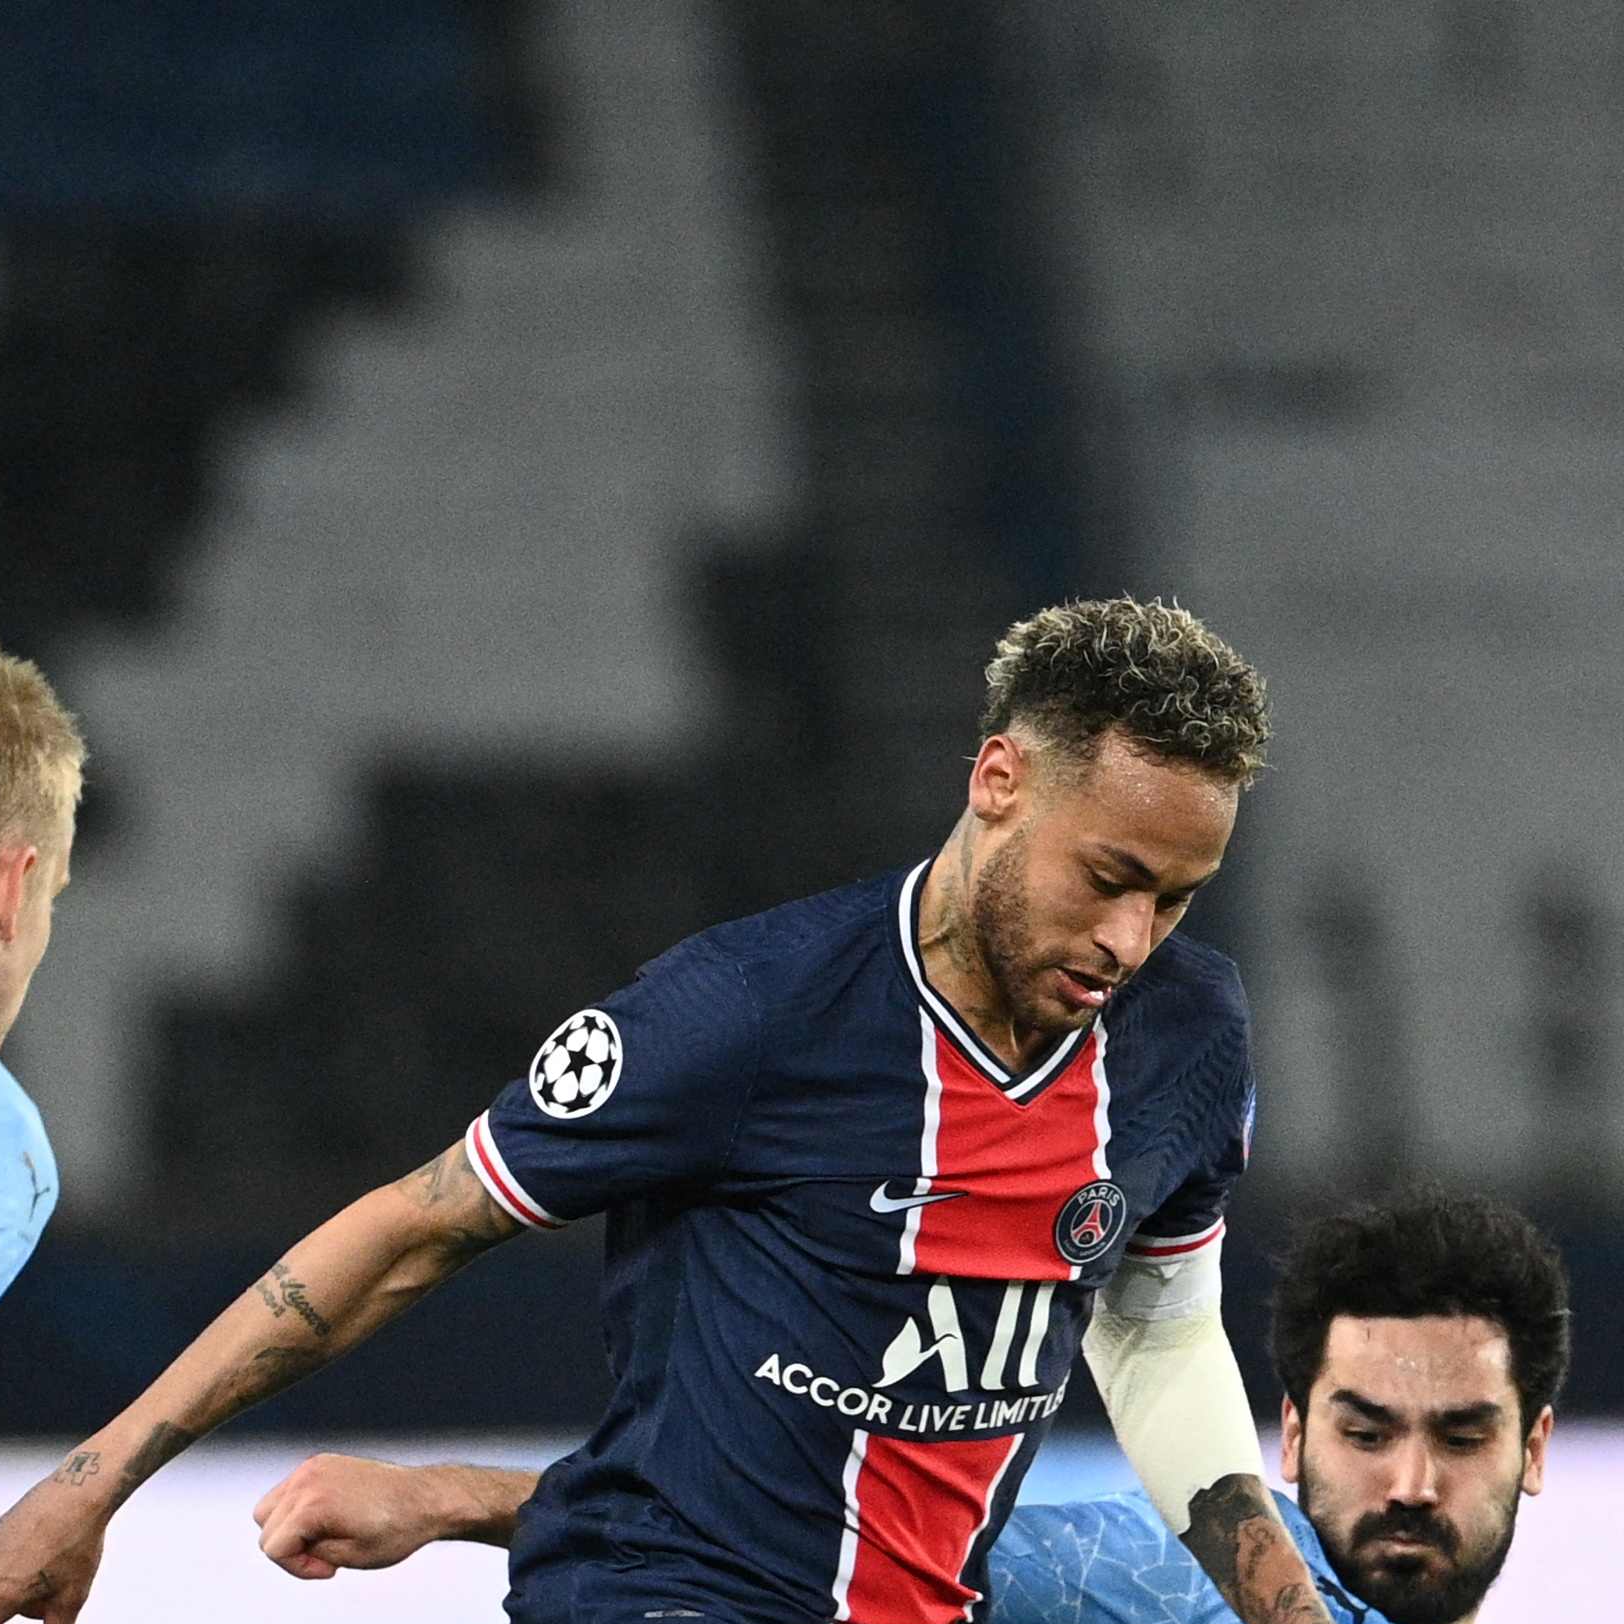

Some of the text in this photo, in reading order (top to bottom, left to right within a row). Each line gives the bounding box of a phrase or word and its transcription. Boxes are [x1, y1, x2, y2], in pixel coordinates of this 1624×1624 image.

[1077, 1186, 1120, 1207] PARIS
[753, 1353, 893, 1425] ACCOR
[897, 1403, 973, 1434] LIVE
